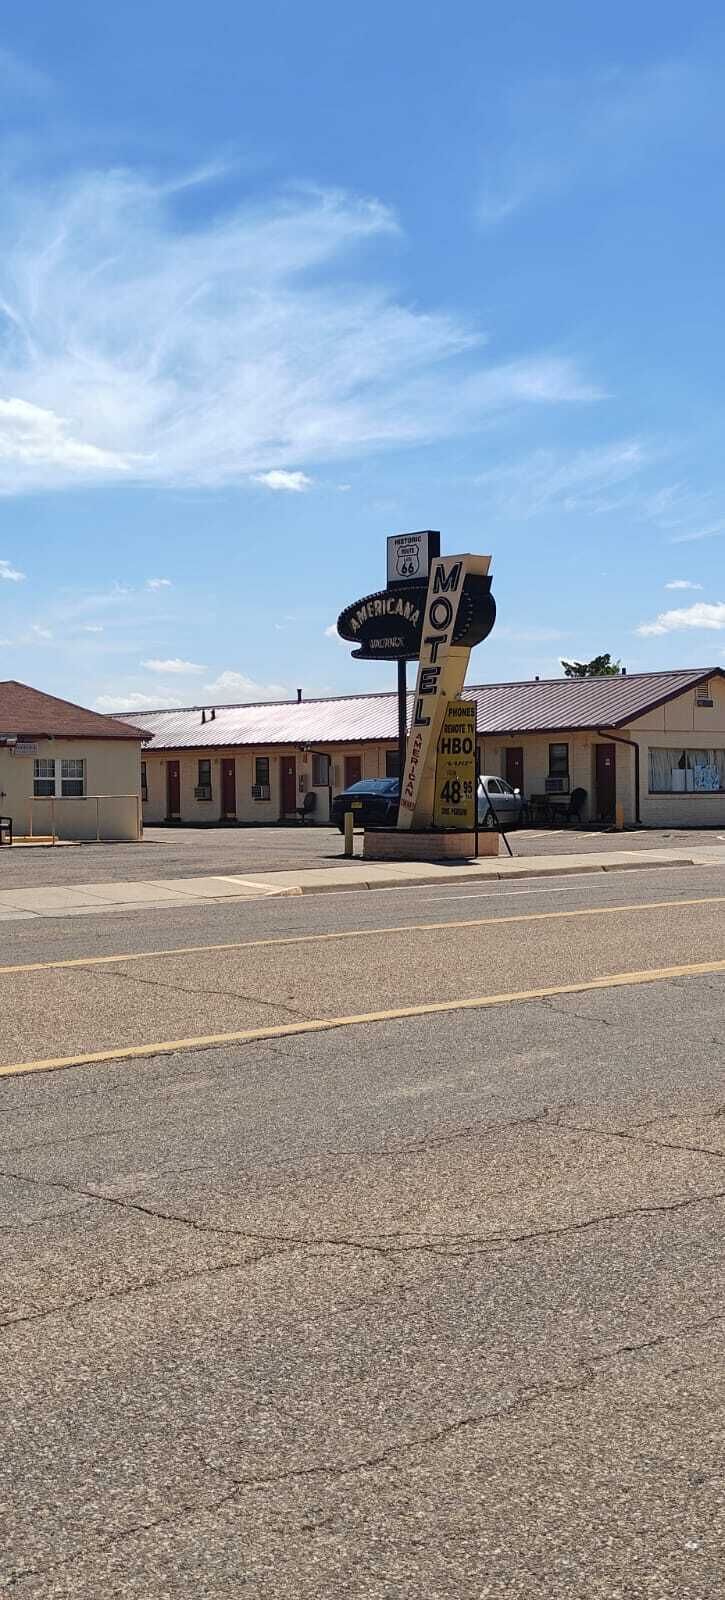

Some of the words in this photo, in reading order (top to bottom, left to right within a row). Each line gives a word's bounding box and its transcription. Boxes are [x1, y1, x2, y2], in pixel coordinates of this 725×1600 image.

[394, 535, 422, 545] HISTORIC
[401, 562, 415, 574] 66
[350, 598, 420, 634] AMERICANA
[414, 562, 463, 727] MOTEL
[448, 706, 475, 717] PHONES
[444, 723, 466, 734] REMOTE
[467, 723, 475, 734] TV
[441, 737, 473, 754] HBO
[405, 733, 423, 797] AMERICAN
[440, 780, 461, 803] 48
[464, 780, 473, 793] 95
